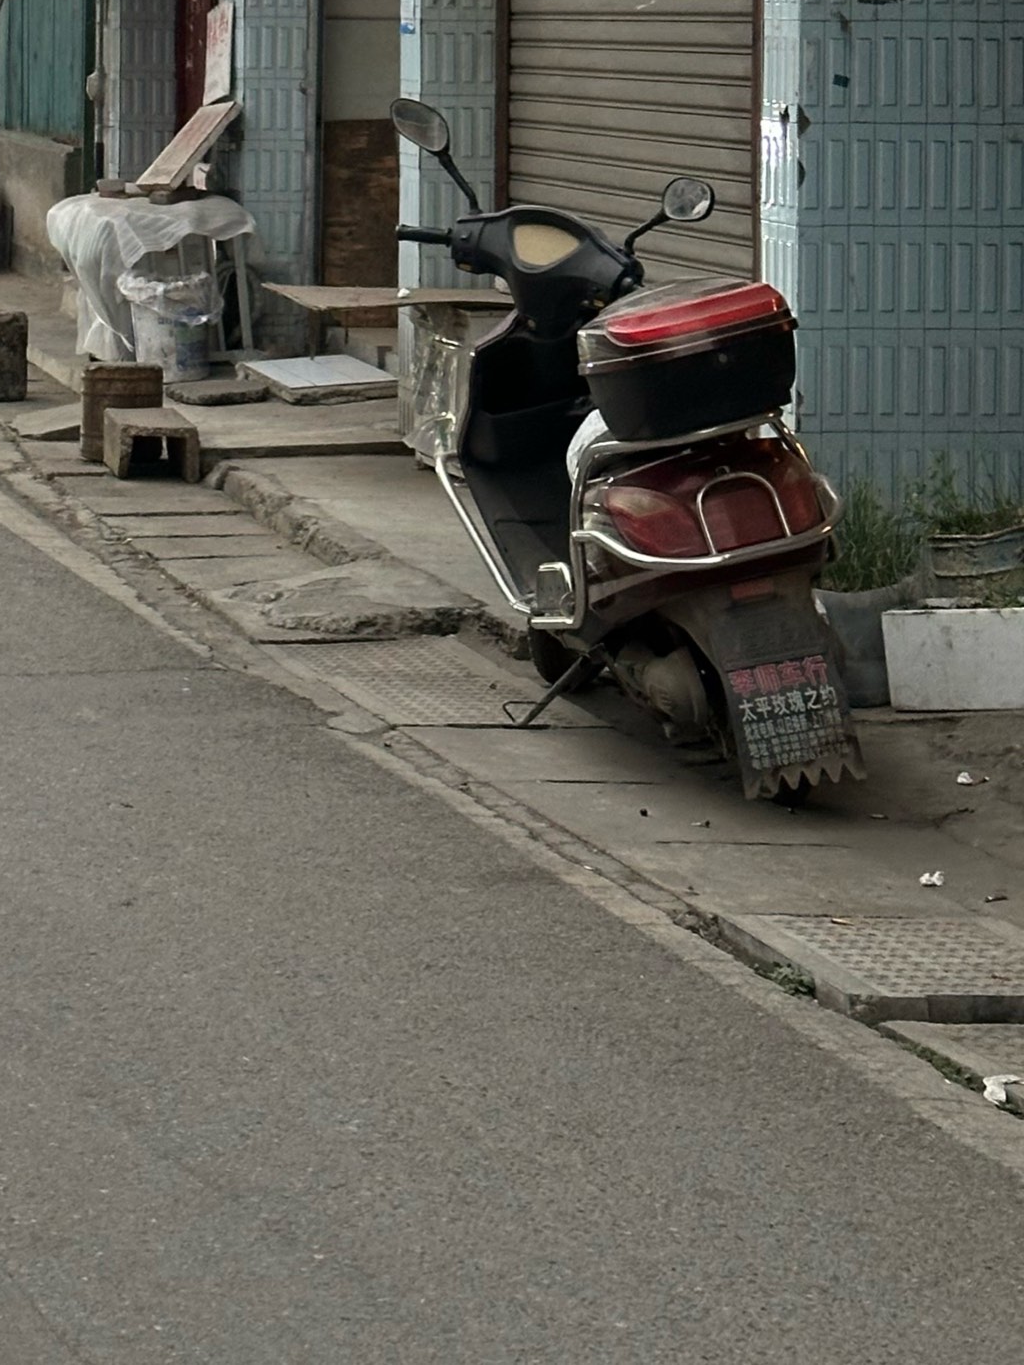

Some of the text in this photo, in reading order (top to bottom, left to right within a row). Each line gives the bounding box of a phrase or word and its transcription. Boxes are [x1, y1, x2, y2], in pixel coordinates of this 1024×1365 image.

[738, 683, 838, 723] 太平玫瑰之约
